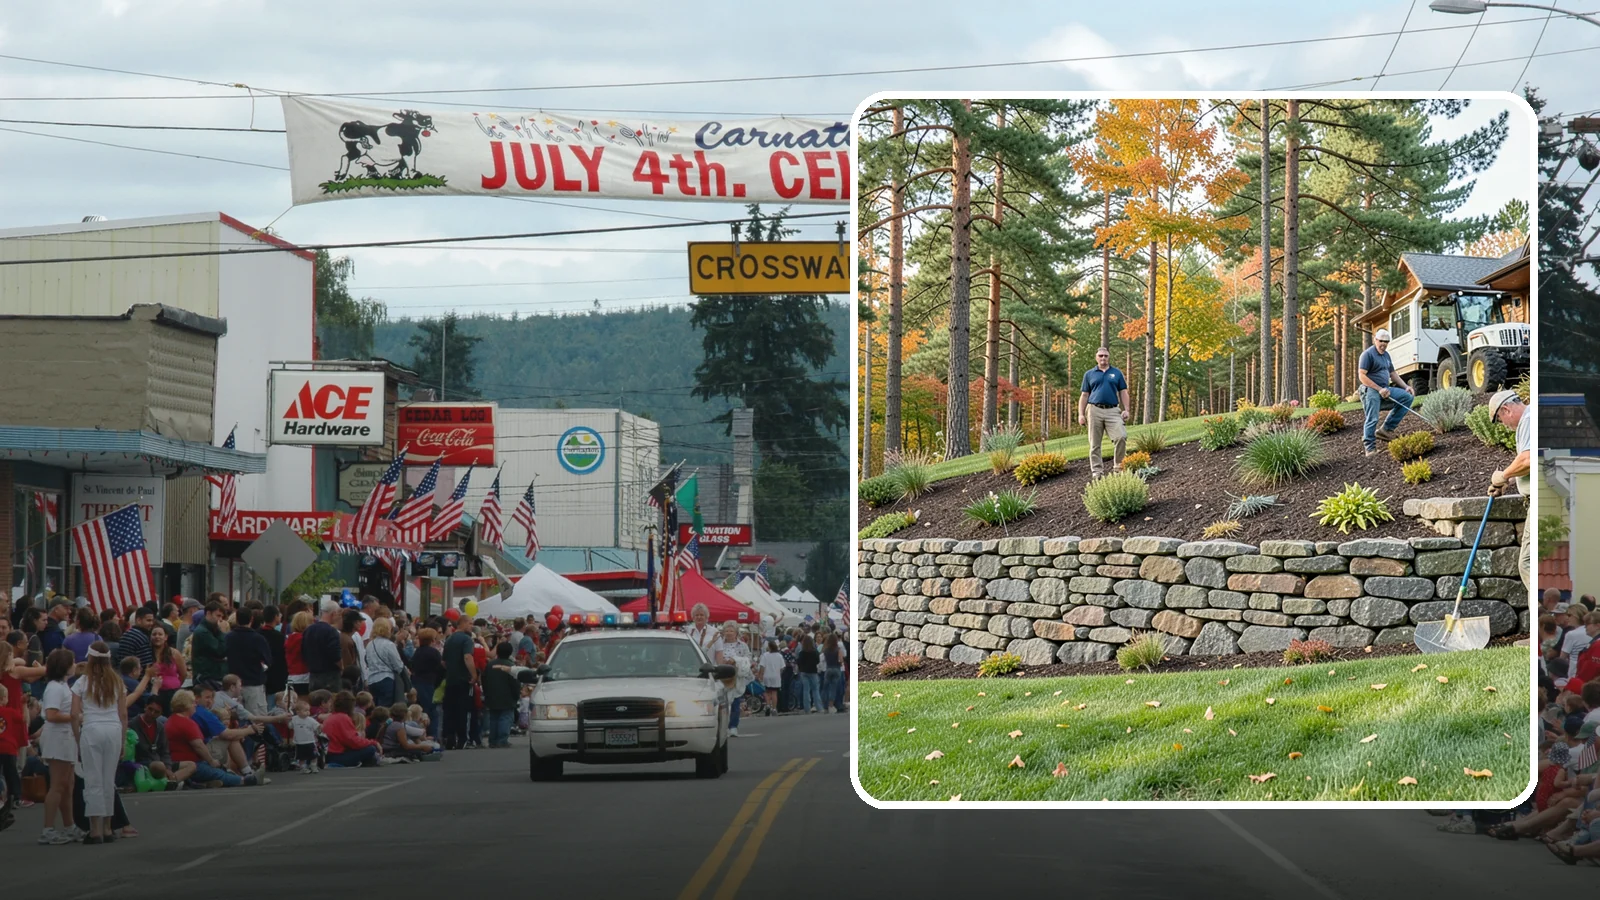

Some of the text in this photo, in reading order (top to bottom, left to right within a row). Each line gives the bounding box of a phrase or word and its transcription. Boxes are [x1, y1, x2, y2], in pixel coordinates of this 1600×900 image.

[481, 141, 605, 192] JULY
[632, 149, 746, 197] 4th.
[696, 253, 850, 281] CROSSWA
[282, 379, 374, 420] ACE
[405, 409, 452, 422] CEDAR
[283, 420, 371, 436] Hardware
[416, 427, 477, 447] Coca-Cola
[96, 485, 124, 495] Vincent
[126, 486, 136, 495] de
[138, 486, 155, 495] Paul
[688, 526, 741, 535] CRNATION
[699, 535, 730, 543] GLASS
